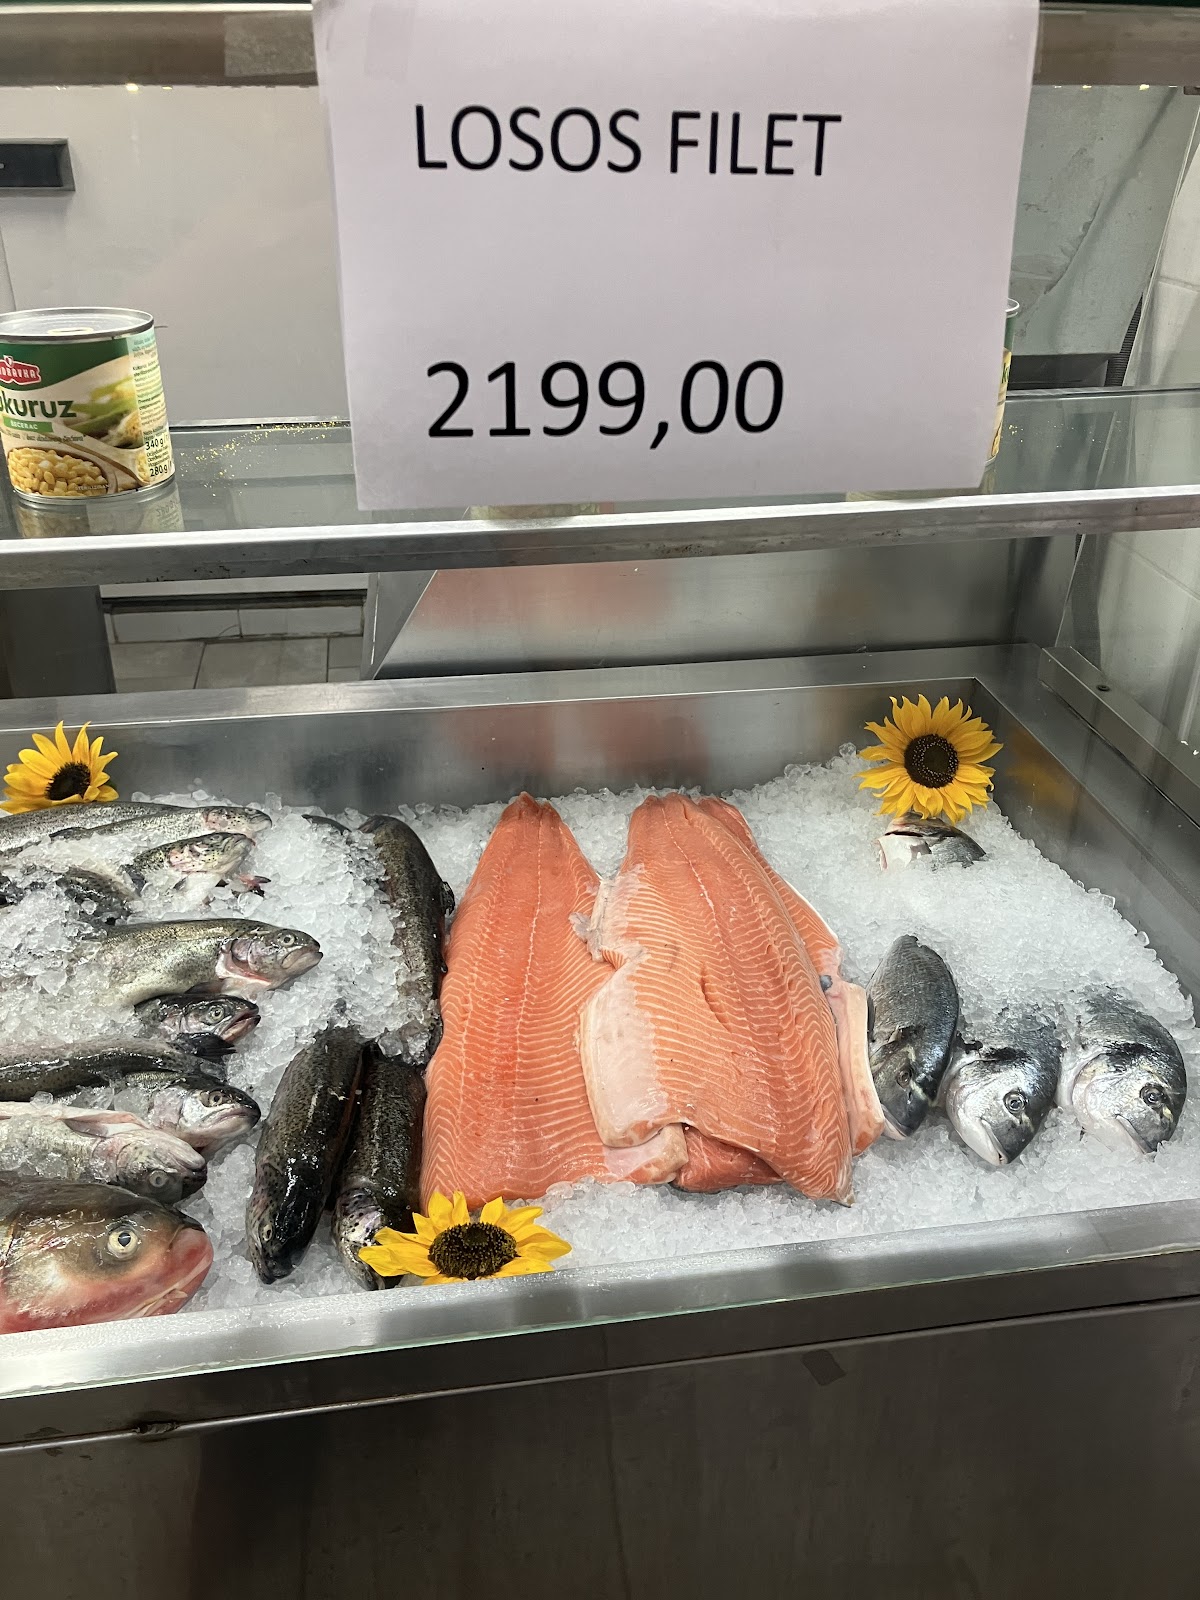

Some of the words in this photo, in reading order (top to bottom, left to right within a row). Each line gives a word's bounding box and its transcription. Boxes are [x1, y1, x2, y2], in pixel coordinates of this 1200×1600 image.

[414, 104, 642, 173] LOSOS
[670, 110, 843, 177] FILET
[0, 390, 77, 418] kuruz
[427, 359, 785, 450] 2199,00
